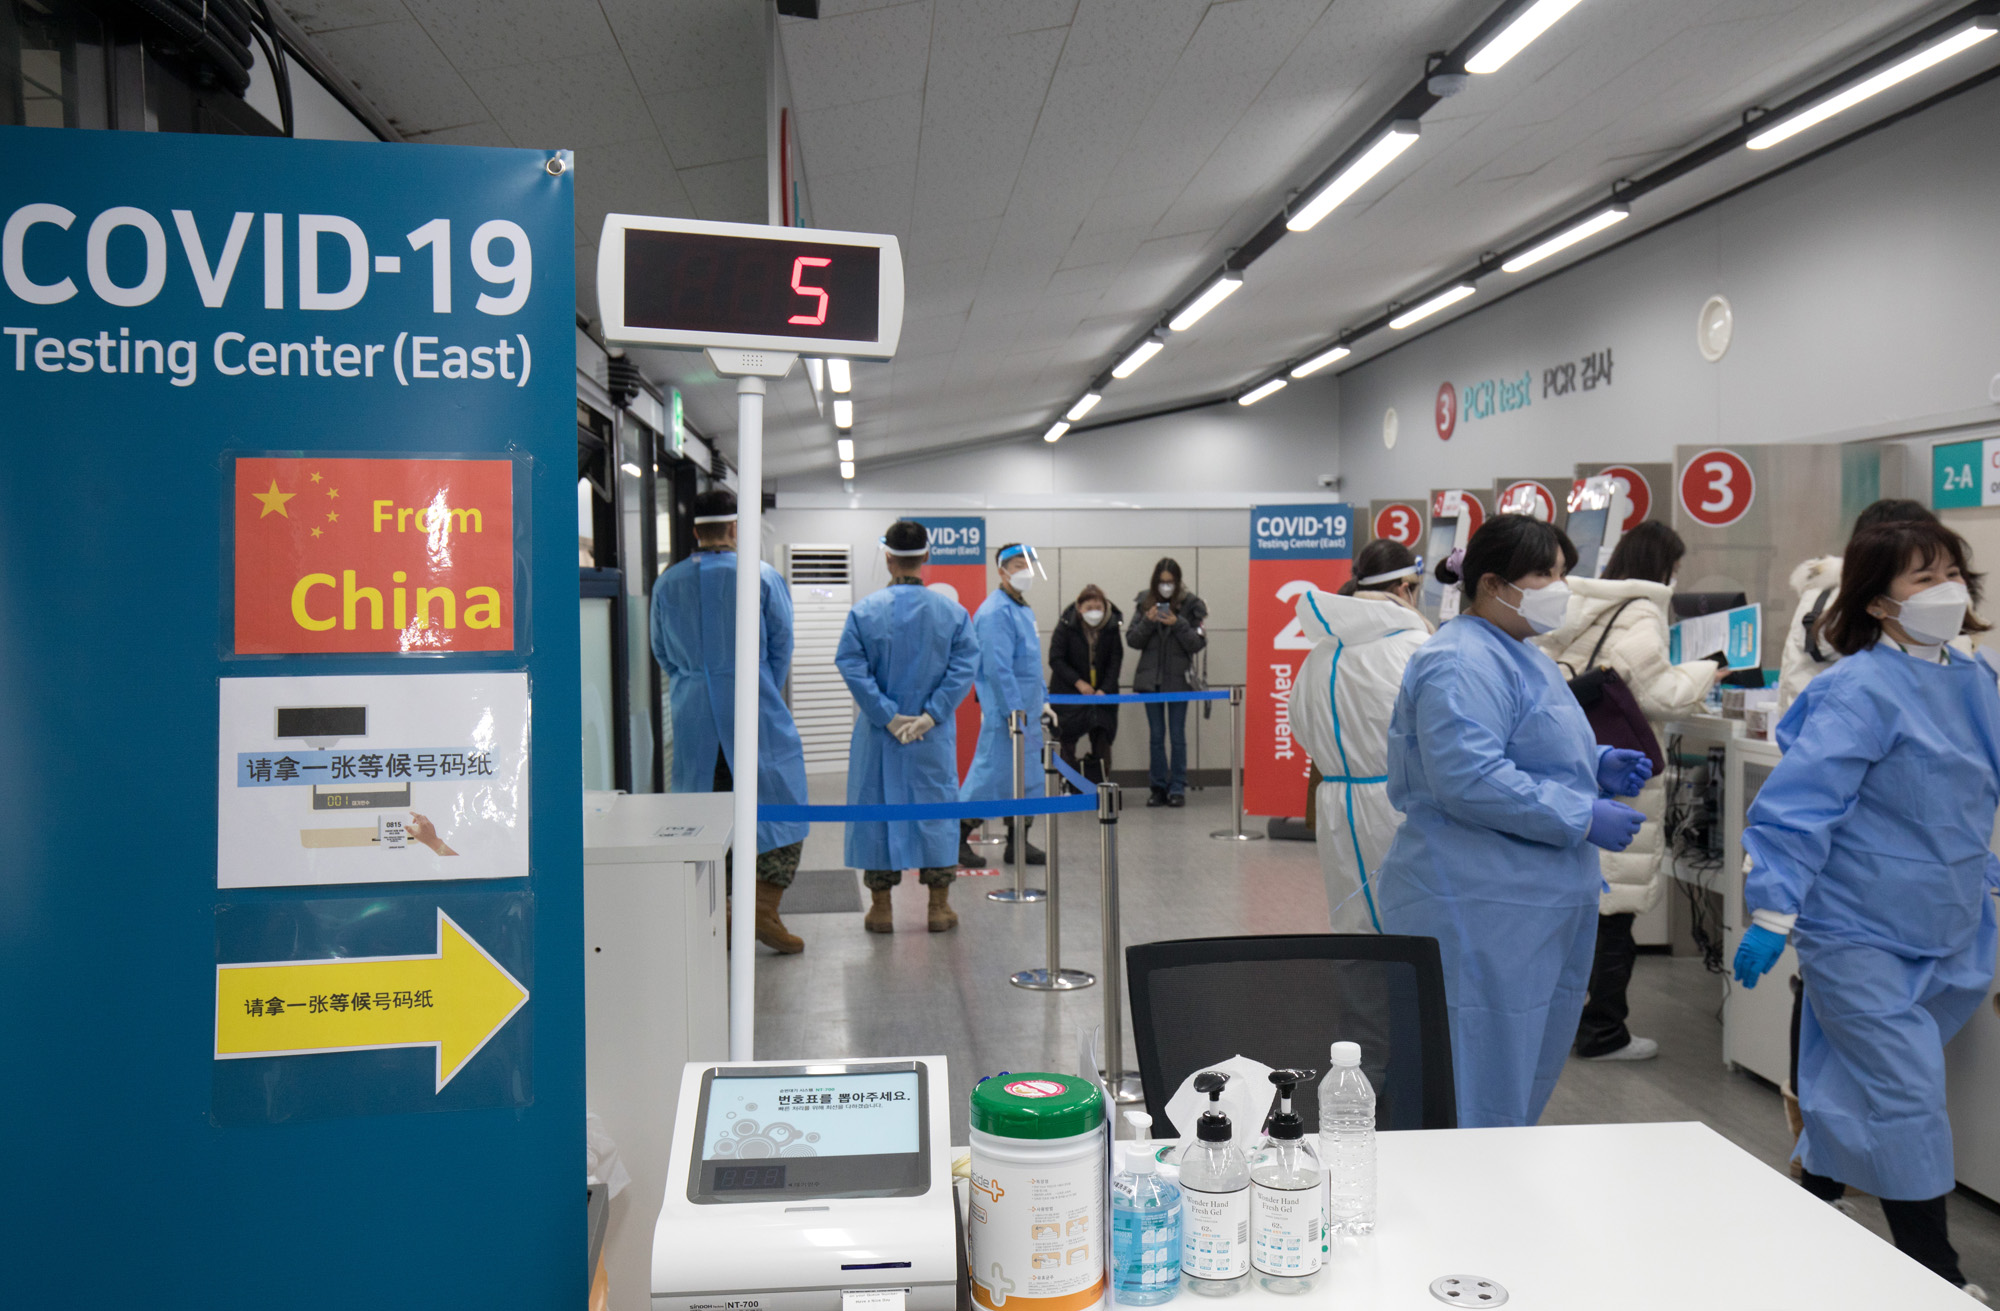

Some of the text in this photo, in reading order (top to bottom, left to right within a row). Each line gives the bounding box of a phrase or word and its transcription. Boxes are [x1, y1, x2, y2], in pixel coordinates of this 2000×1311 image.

[2, 203, 533, 316] COVID-19
[788, 256, 832, 326] 5
[4, 327, 532, 387] Testing Center (East)
[1543, 347, 1614, 399] PCR 검사
[1463, 370, 1532, 422] PCR test
[1440, 394, 1450, 431] 3
[1701, 461, 1734, 513] 3
[1943, 464, 1974, 490] 2-A
[373, 499, 483, 533] From
[1256, 516, 1348, 537] COVID-19
[1389, 510, 1409, 543] 3
[926, 527, 980, 545] VID-19
[931, 545, 981, 556] Center (East)
[1257, 537, 1346, 551] Testing Center (East)
[290, 569, 502, 632] China
[1274, 580, 1321, 650] 2
[1270, 664, 1296, 760] payment
[246, 753, 493, 783] 请拿一张等候号码纸
[244, 989, 434, 1018] 请拿一张等候号码纸
[778, 1090, 911, 1106] 번호표를 뽑아주세요.
[1187, 1195, 1209, 1207] Wonder
[1192, 1205, 1209, 1215] Fresh
[1257, 1192, 1279, 1204] Wonder
[1263, 1202, 1279, 1212] Fresh
[727, 1301, 759, 1309] NT-700
